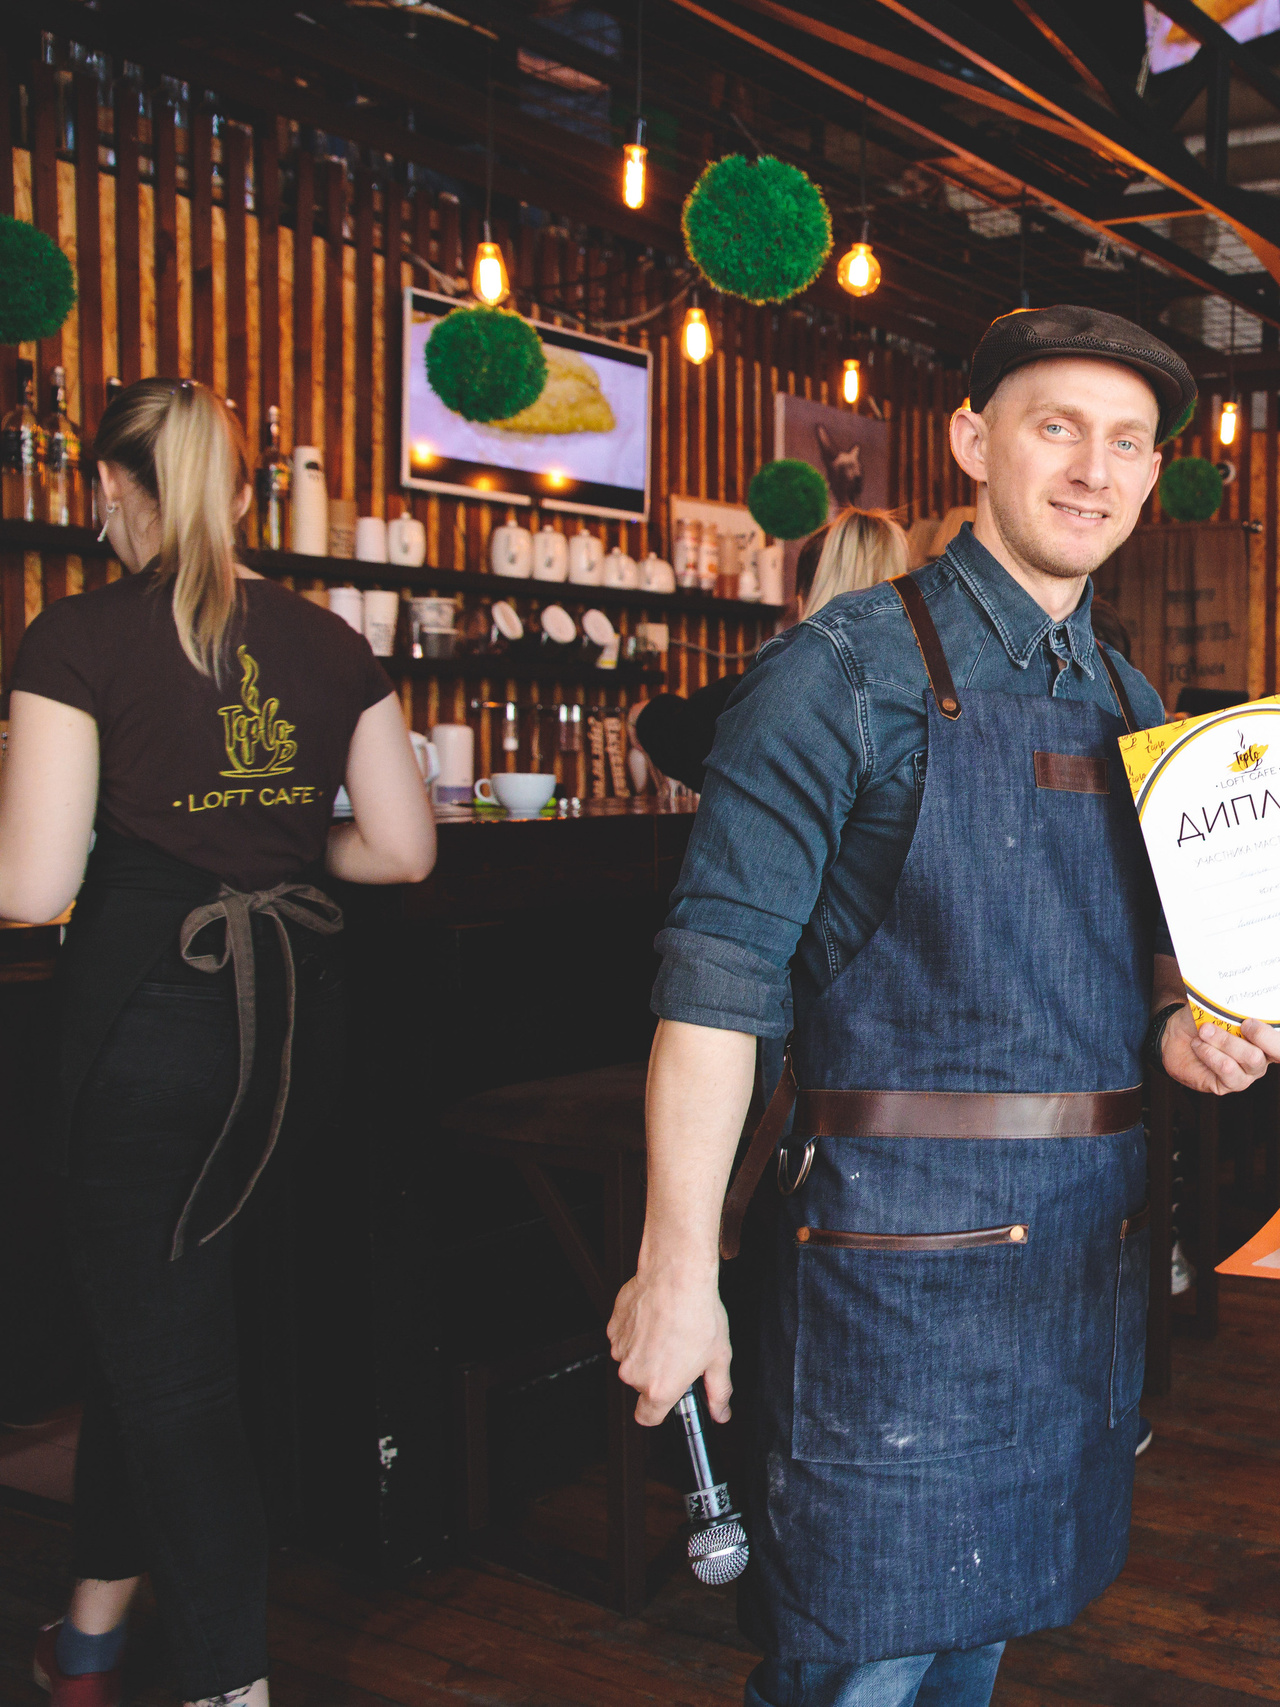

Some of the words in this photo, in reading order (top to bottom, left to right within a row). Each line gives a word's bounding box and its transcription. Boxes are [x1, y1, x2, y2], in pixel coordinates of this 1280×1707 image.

[1233, 745, 1260, 768] Teplo
[1220, 775, 1246, 789] LOFT
[1249, 766, 1277, 781] CAFE
[188, 788, 254, 812] LOFT
[259, 786, 315, 806] CAFE
[1195, 844, 1252, 868] УЧАСТНИКА
